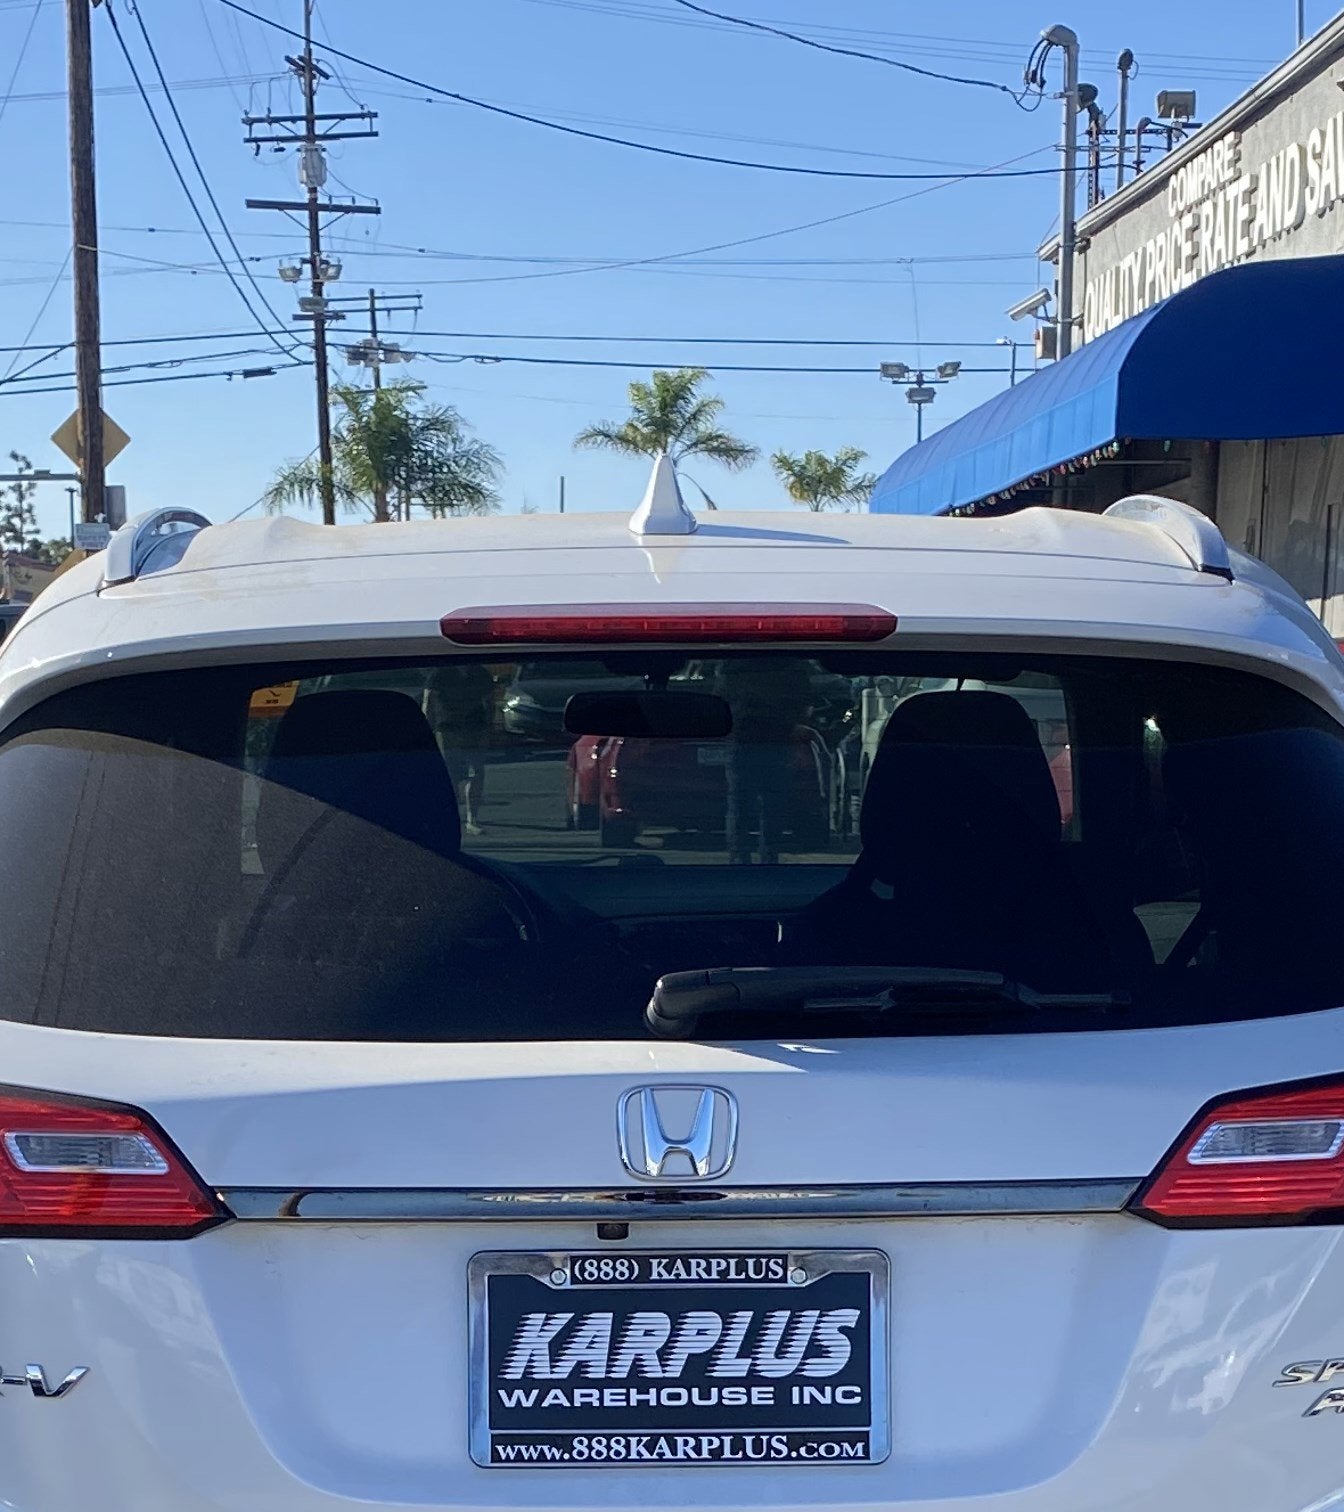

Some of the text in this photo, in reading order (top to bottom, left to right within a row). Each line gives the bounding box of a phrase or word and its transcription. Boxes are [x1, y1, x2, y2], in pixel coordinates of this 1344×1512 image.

[1168, 131, 1236, 217] COMPARE
[1201, 173, 1251, 275] RATE
[1253, 142, 1302, 245] AND
[573, 1257, 784, 1281] (888) KARPLUS
[497, 1308, 861, 1380] KARPLUS
[498, 1385, 862, 1408] WAREHOUSE INC
